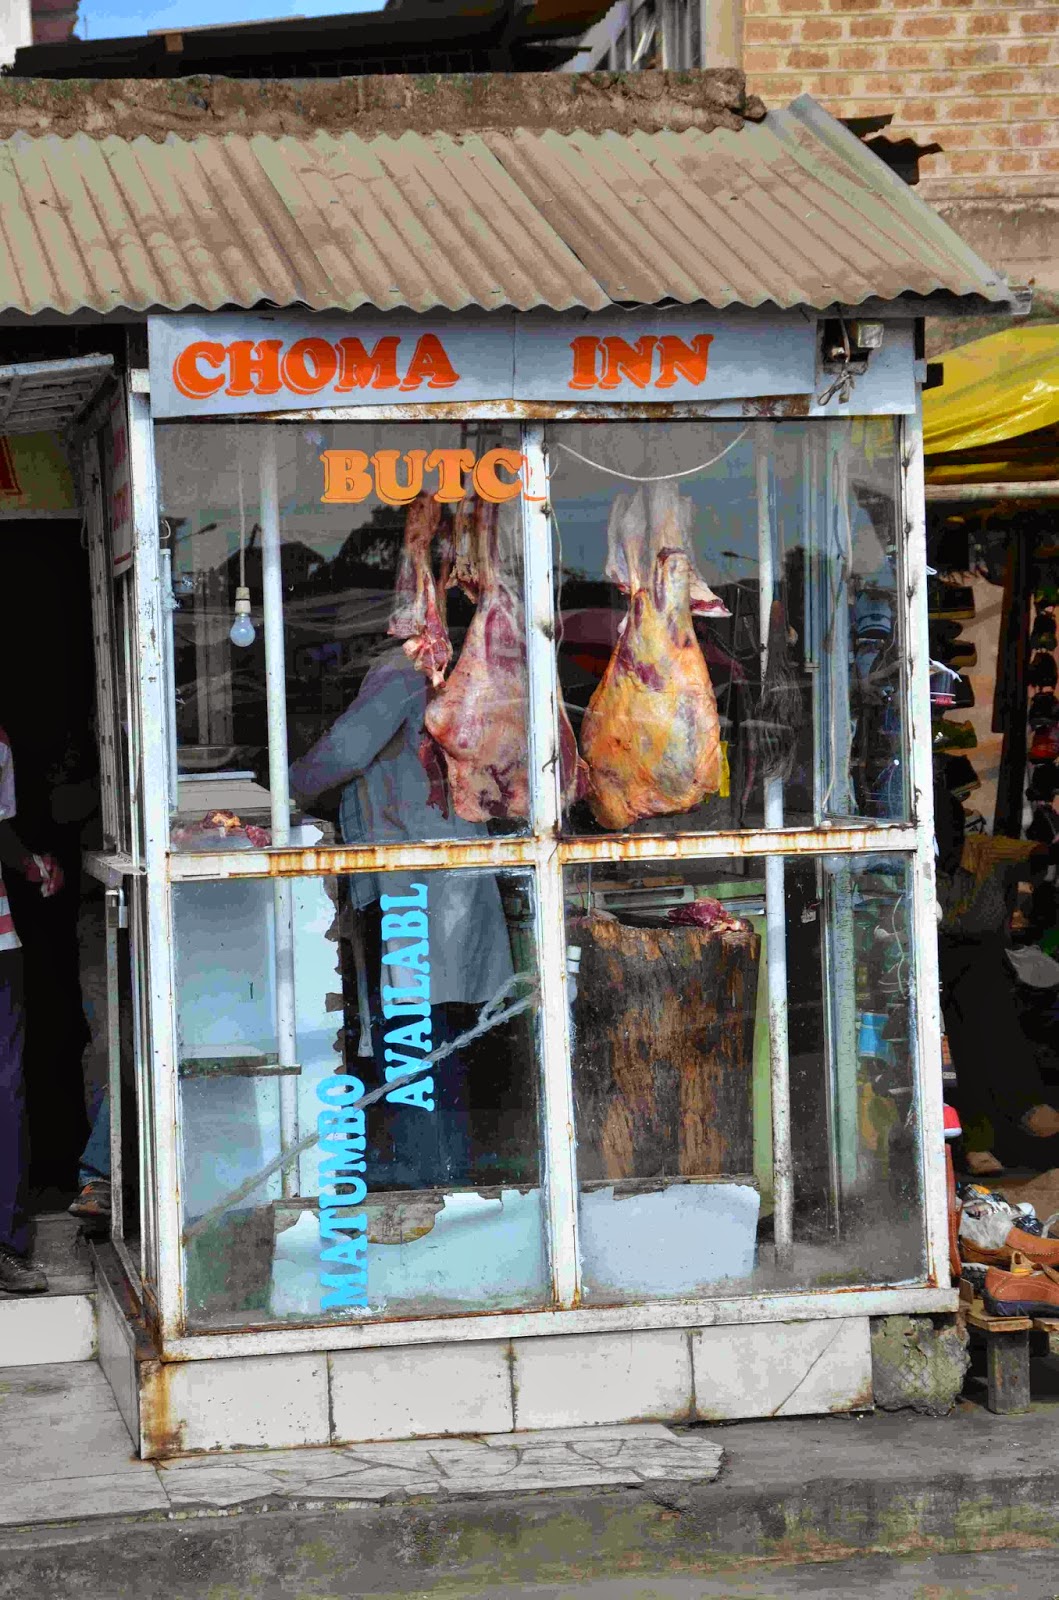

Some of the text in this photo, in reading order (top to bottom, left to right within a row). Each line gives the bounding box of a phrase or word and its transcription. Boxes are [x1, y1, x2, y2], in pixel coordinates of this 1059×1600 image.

[172, 333, 715, 399] CHOMA INN
[319, 447, 547, 505] BUTC
[380, 883, 435, 1112] AVAILABL
[316, 1074, 369, 1309] MATUMBO
